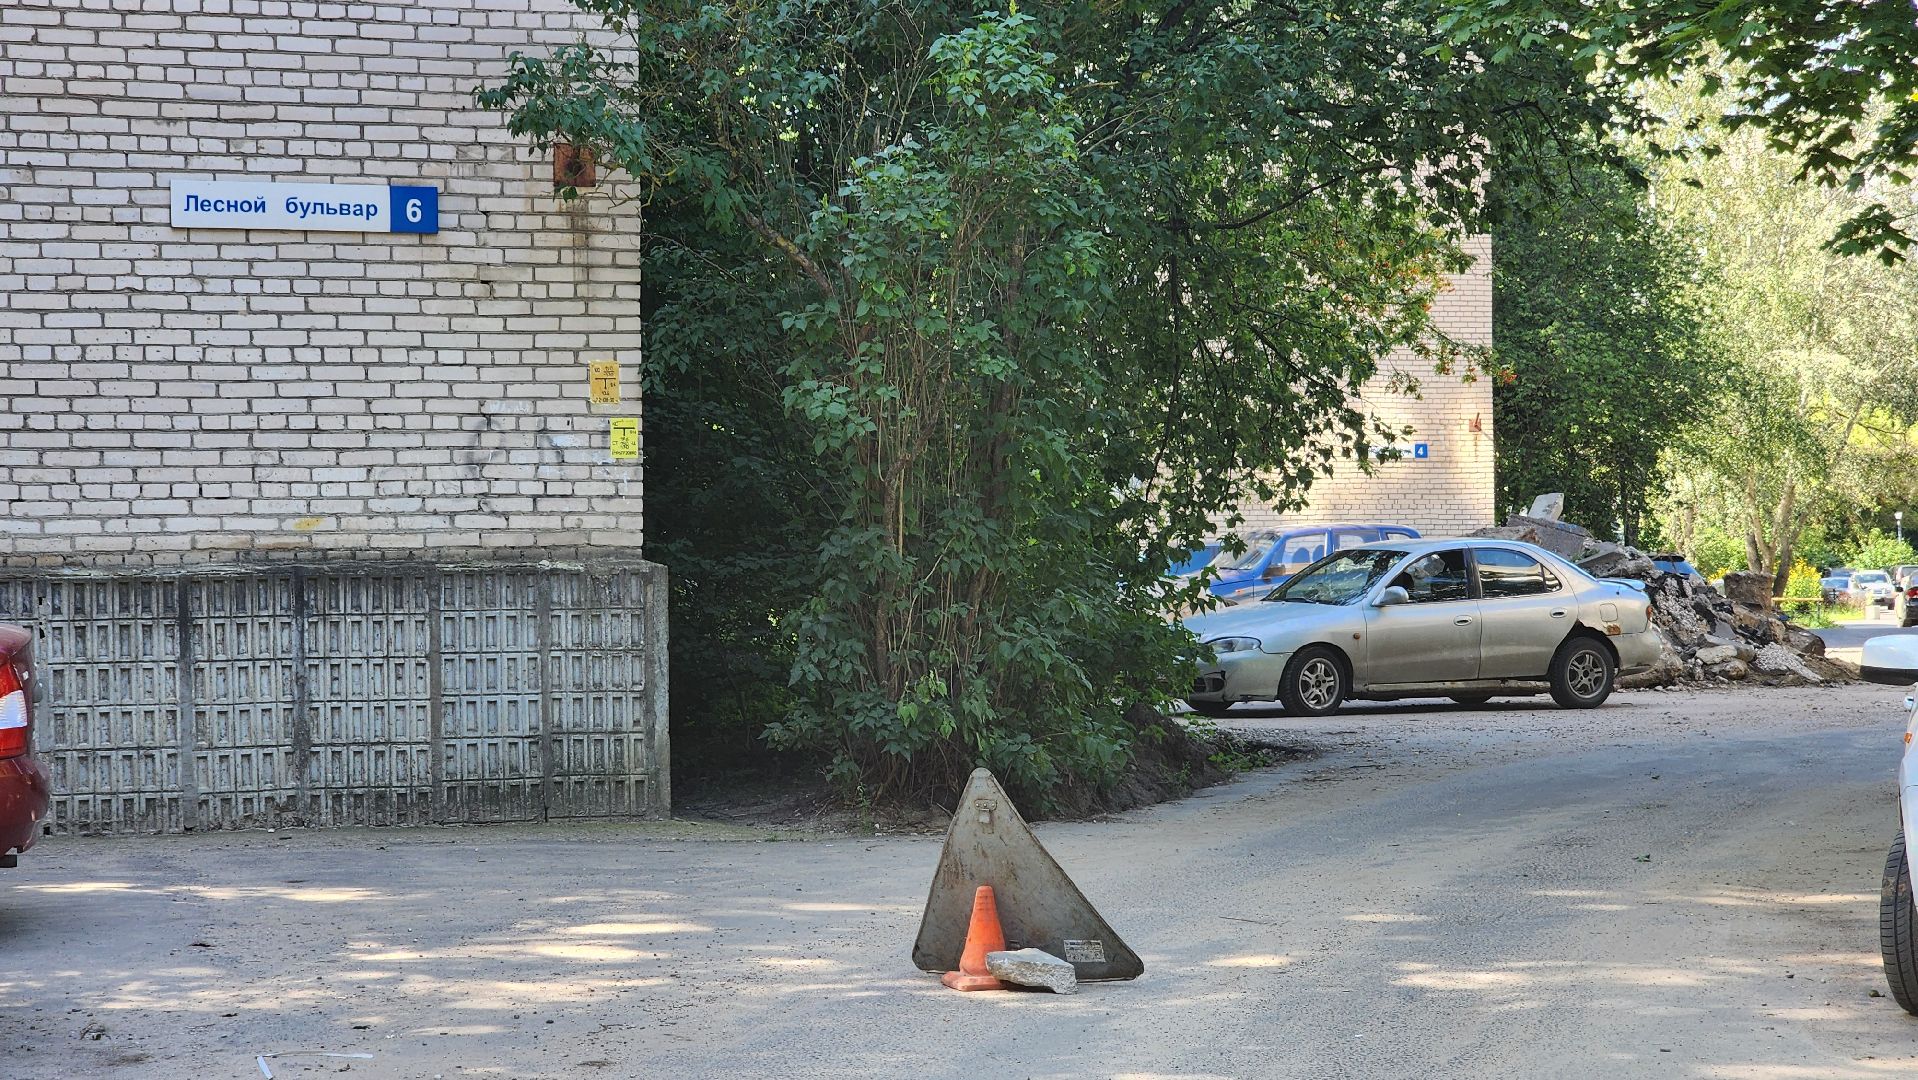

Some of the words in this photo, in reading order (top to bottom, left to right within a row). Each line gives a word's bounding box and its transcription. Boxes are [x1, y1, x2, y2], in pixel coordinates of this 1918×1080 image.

[184, 194, 266, 213] Лесной
[285, 197, 377, 220] бульвар
[405, 198, 422, 223] 6
[1417, 446, 1424, 455] 4
